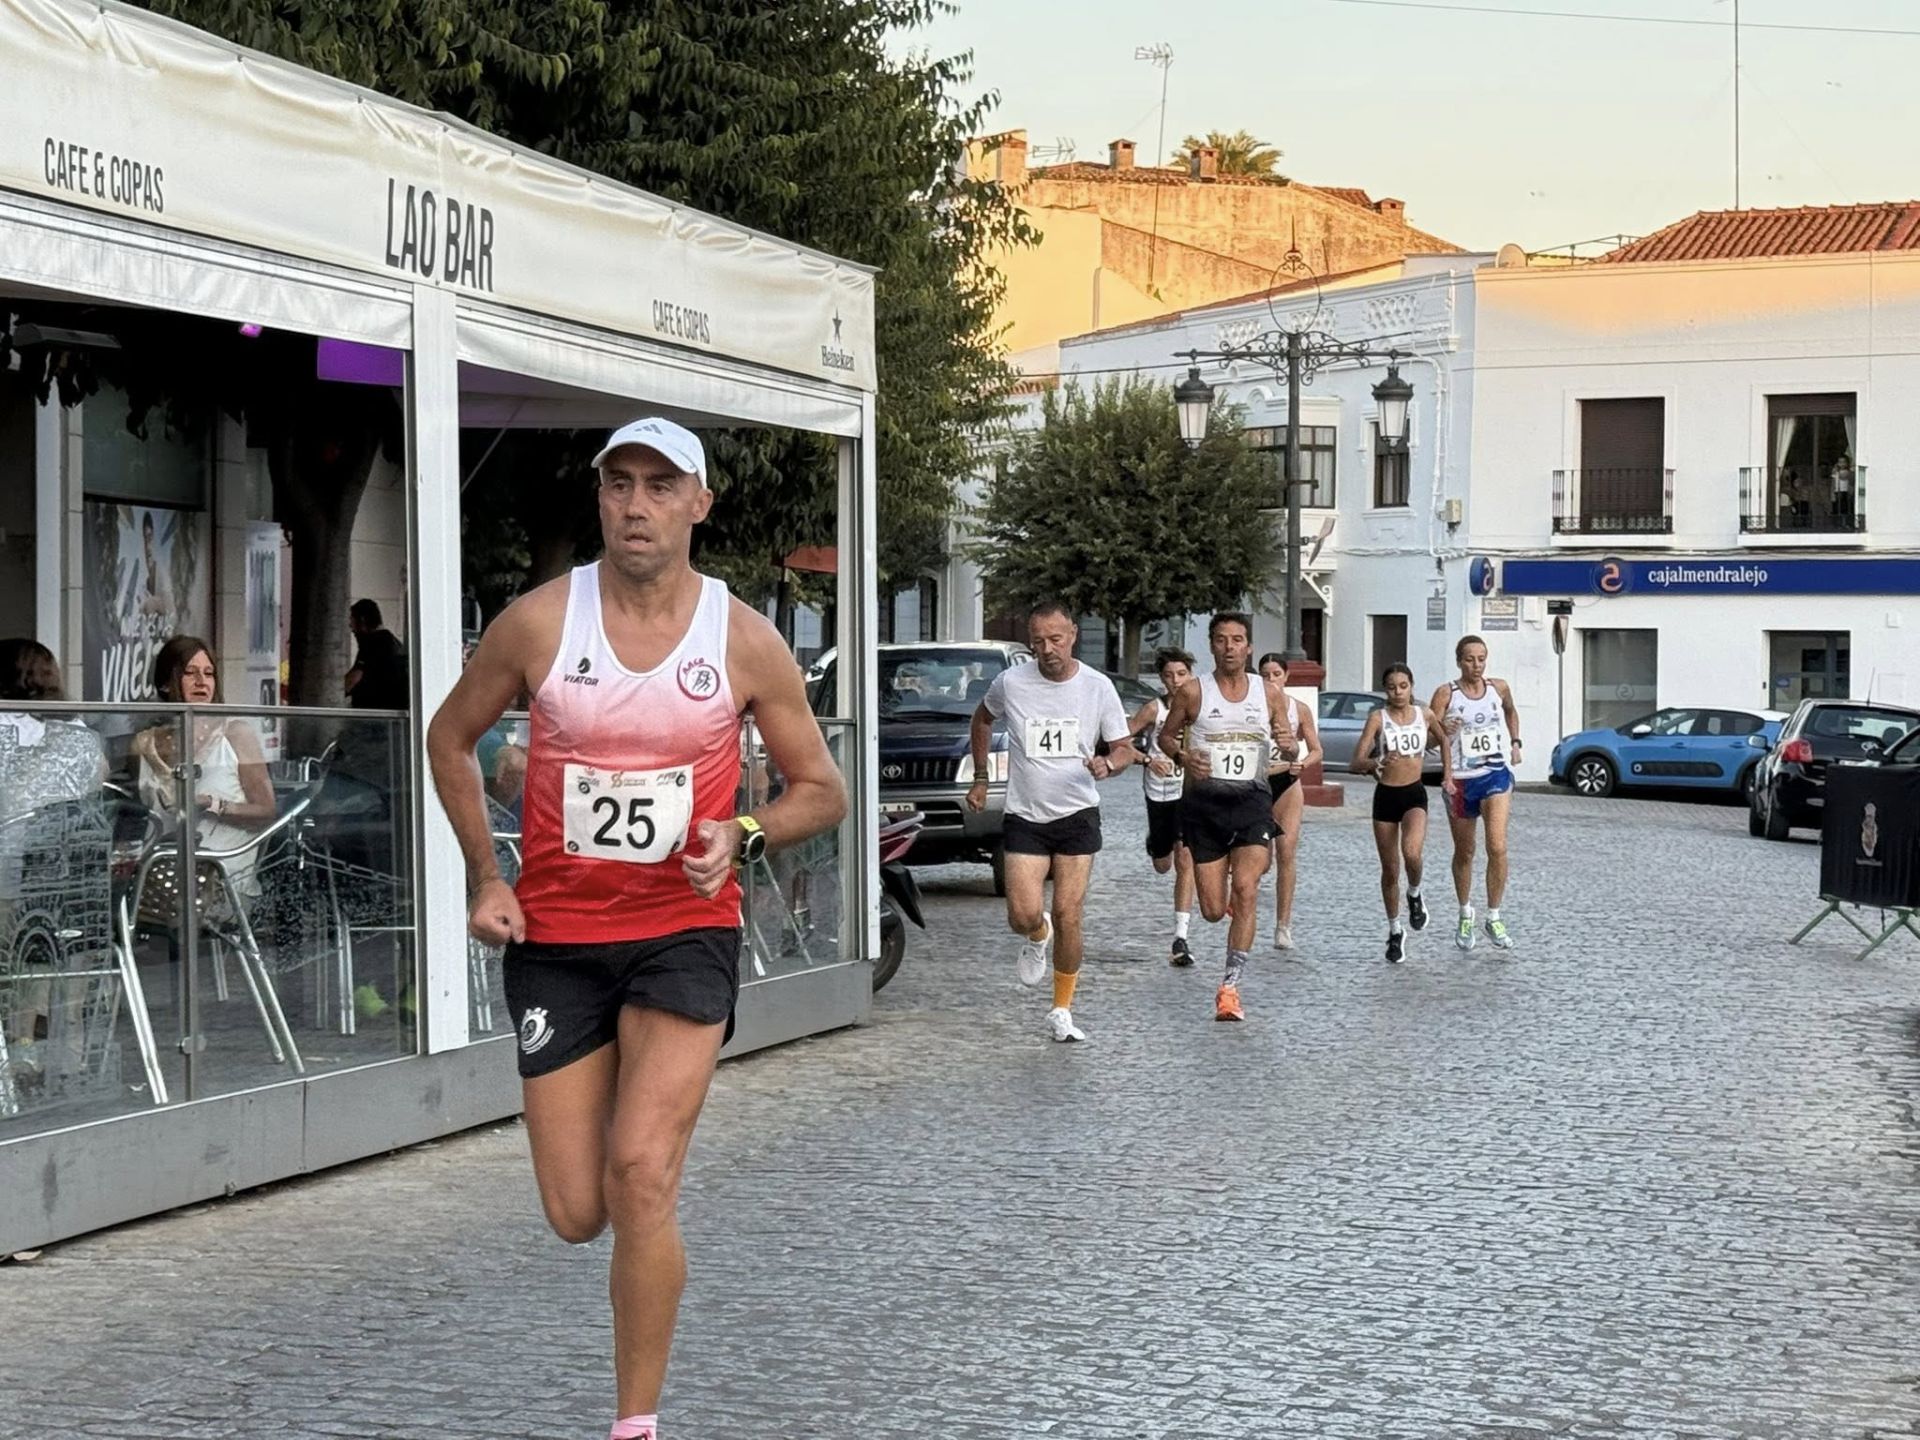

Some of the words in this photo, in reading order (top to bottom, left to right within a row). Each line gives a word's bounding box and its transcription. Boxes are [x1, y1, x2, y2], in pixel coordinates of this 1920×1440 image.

[44, 137, 89, 195] CAFE
[94, 151, 105, 199] &
[110, 155, 163, 214] COPAS
[385, 177, 437, 278] LAO
[444, 197, 494, 293] BAR
[653, 299, 675, 335] CAFE
[683, 307, 710, 344] COPAS
[821, 345, 855, 371] Heineken
[1648, 565, 1768, 587] cajalmendralejo
[563, 673, 599, 687] VIATOR
[1039, 730, 1062, 752] 41
[1391, 733, 1420, 751] 130
[1470, 735, 1491, 752] 46
[1222, 754, 1245, 775] 19
[592, 796, 655, 850] 25
